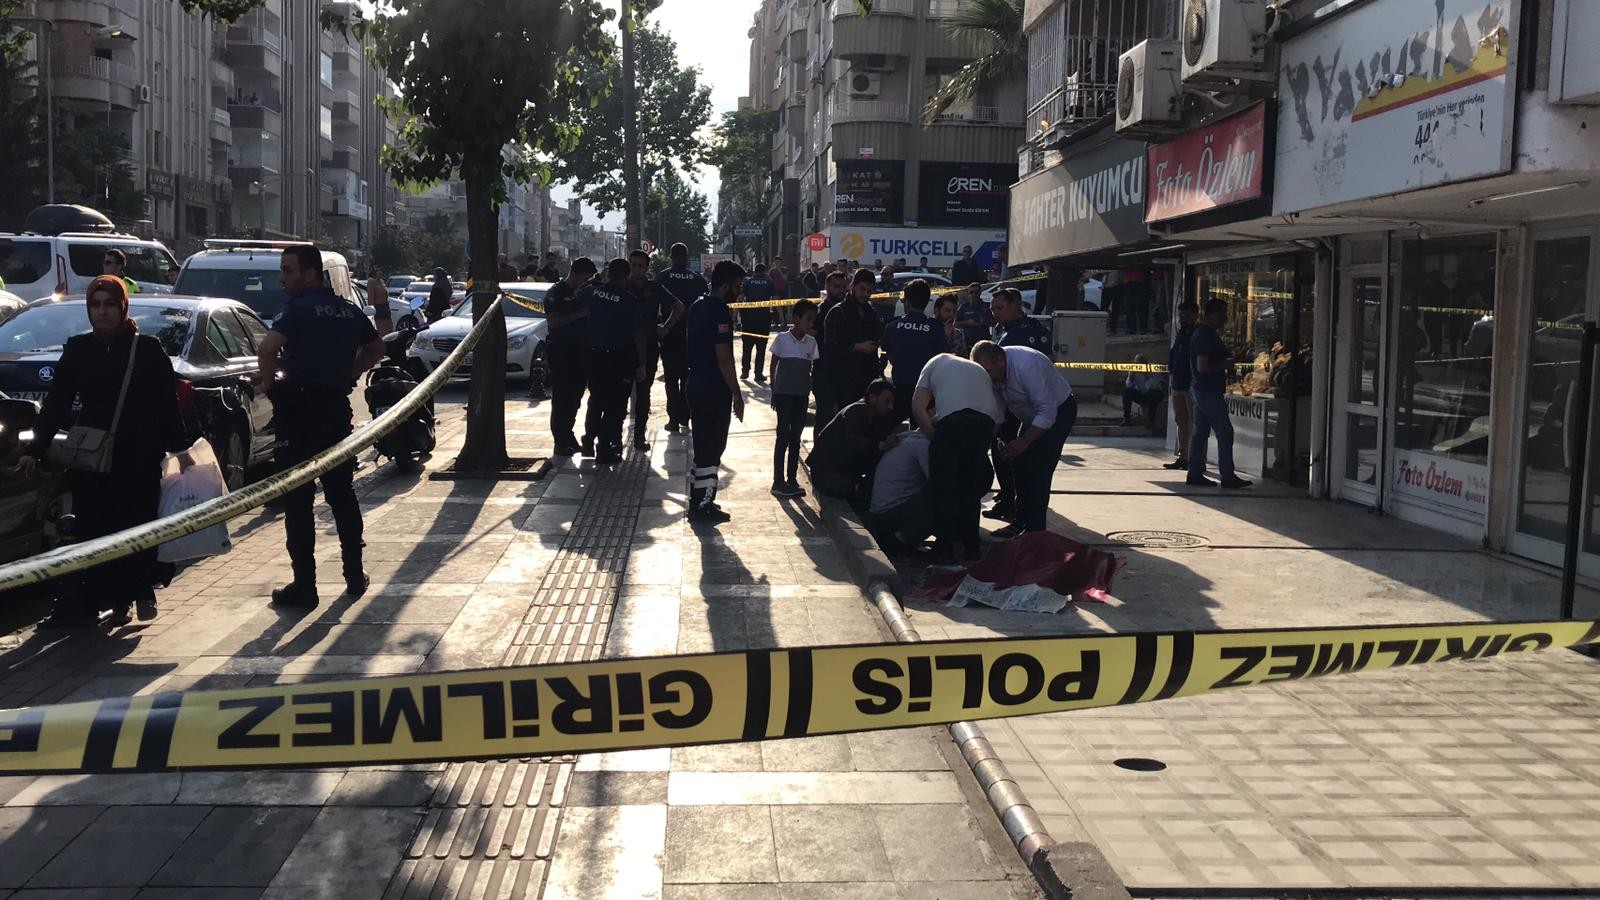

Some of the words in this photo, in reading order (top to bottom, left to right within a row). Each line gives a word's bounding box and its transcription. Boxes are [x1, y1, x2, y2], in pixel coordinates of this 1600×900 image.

[1447, 101, 1457, 113] Her
[1154, 160, 1192, 212] Foto
[1195, 134, 1256, 200] Özlem
[836, 194, 854, 203] REN
[1023, 186, 1066, 236] ZAHTER
[1069, 156, 1144, 224] KUYUMCU
[869, 239, 966, 257] TURKCELL
[1397, 459, 1423, 486] Foto
[1425, 461, 1463, 497] Özlem
